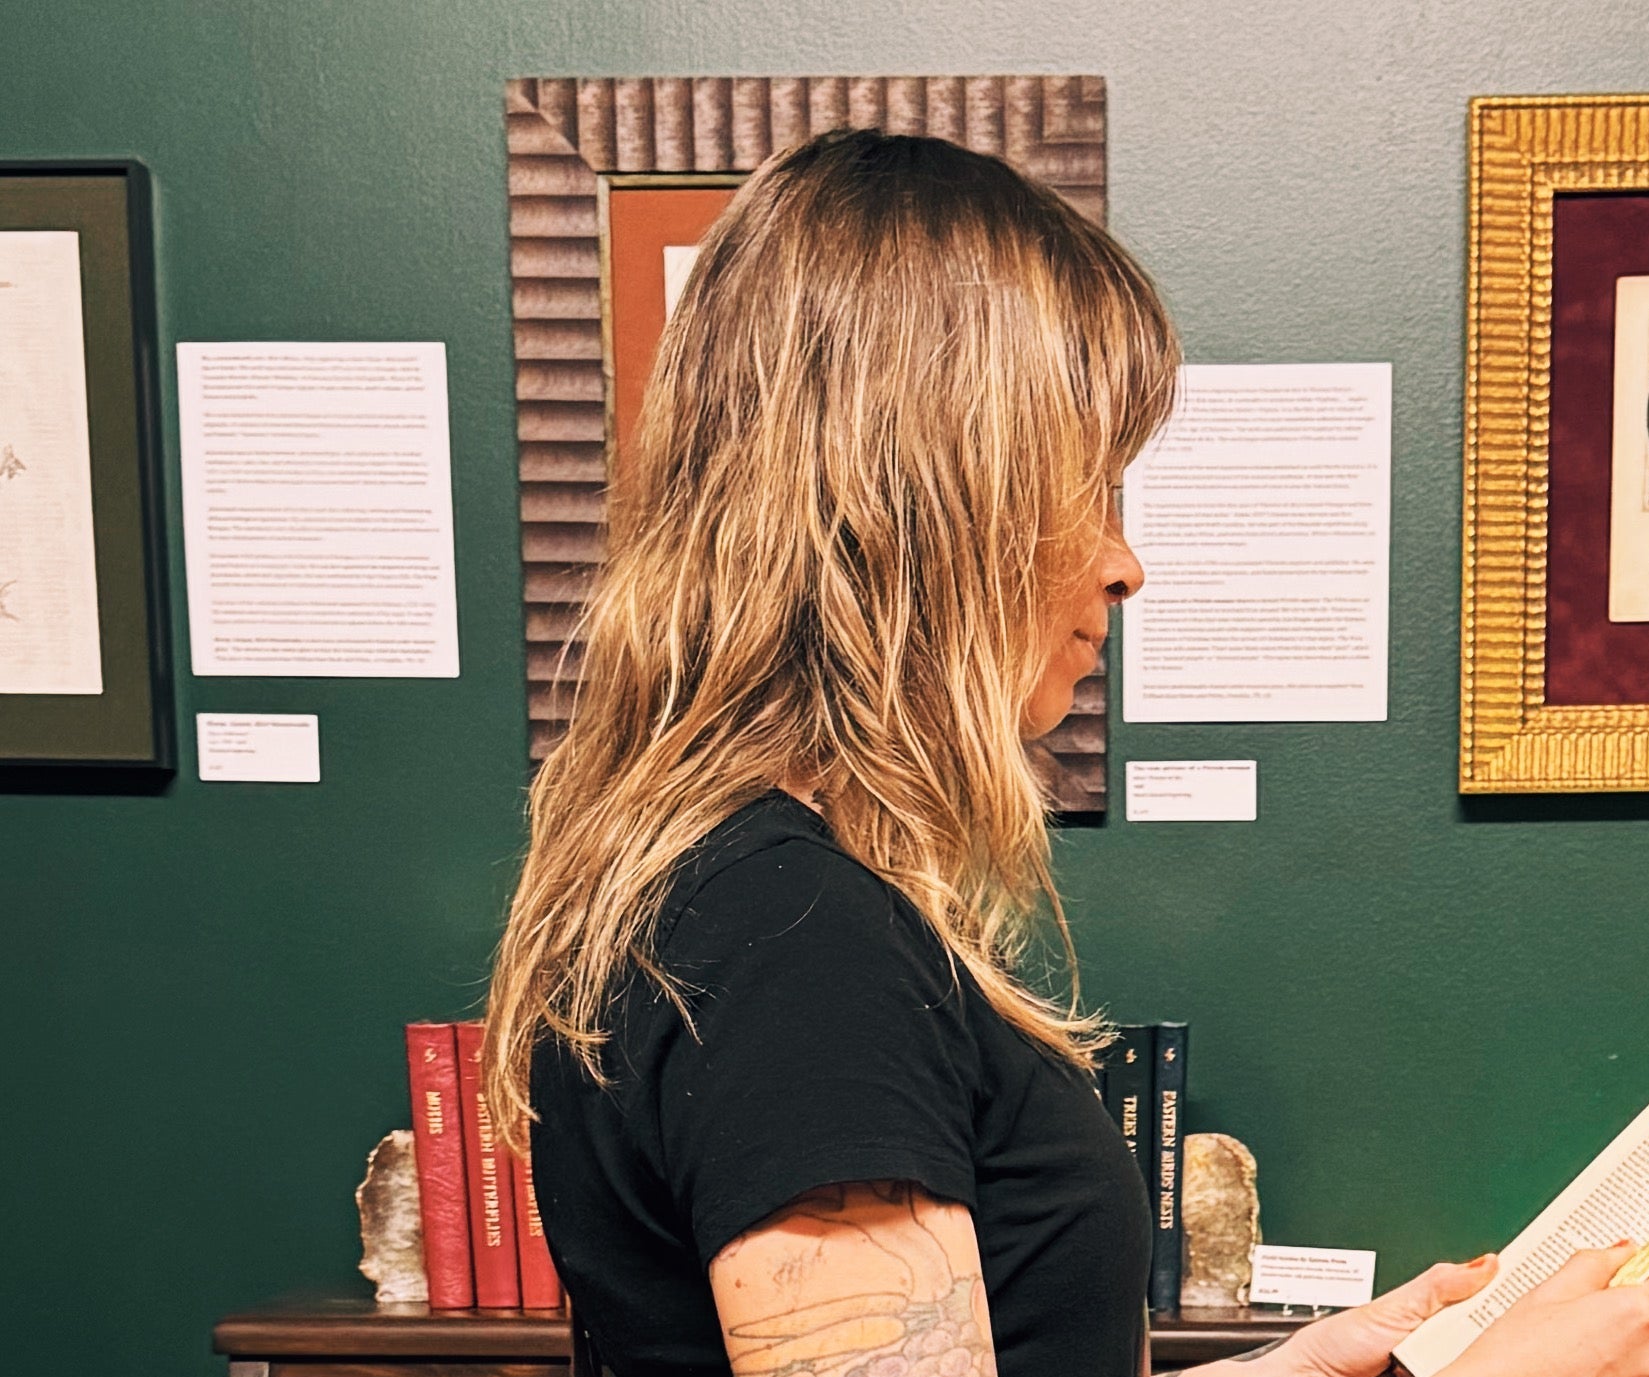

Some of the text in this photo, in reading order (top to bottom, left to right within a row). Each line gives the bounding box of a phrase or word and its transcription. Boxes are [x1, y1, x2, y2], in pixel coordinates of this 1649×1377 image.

[1123, 1095, 1138, 1136] TREES
[1162, 1090, 1177, 1147] EASTERN
[1159, 1190, 1175, 1230] NESTS
